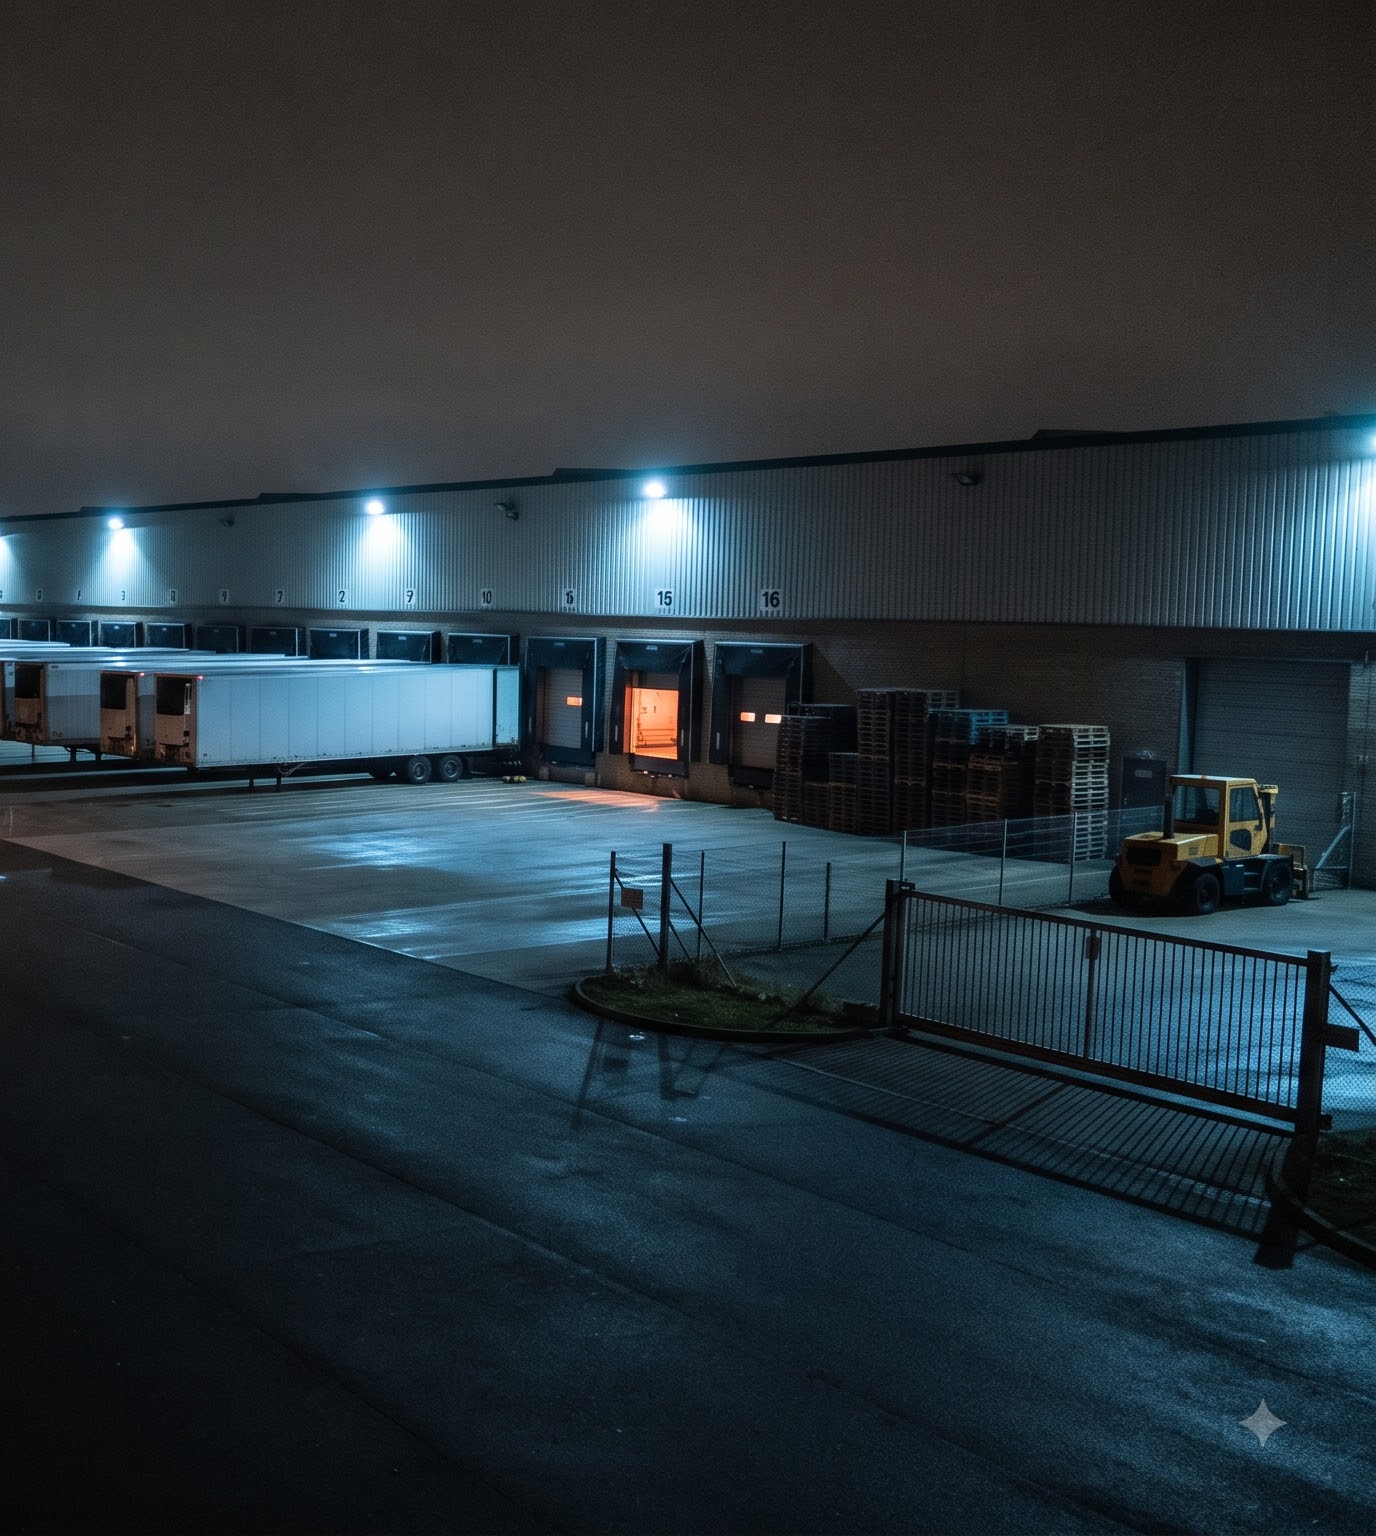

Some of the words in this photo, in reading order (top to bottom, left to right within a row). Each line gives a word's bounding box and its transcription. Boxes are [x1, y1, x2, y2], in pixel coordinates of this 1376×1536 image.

[339, 591, 345, 602] 2
[483, 591, 491, 604] 10
[657, 591, 672, 606] 15
[762, 591, 780, 607] 16
